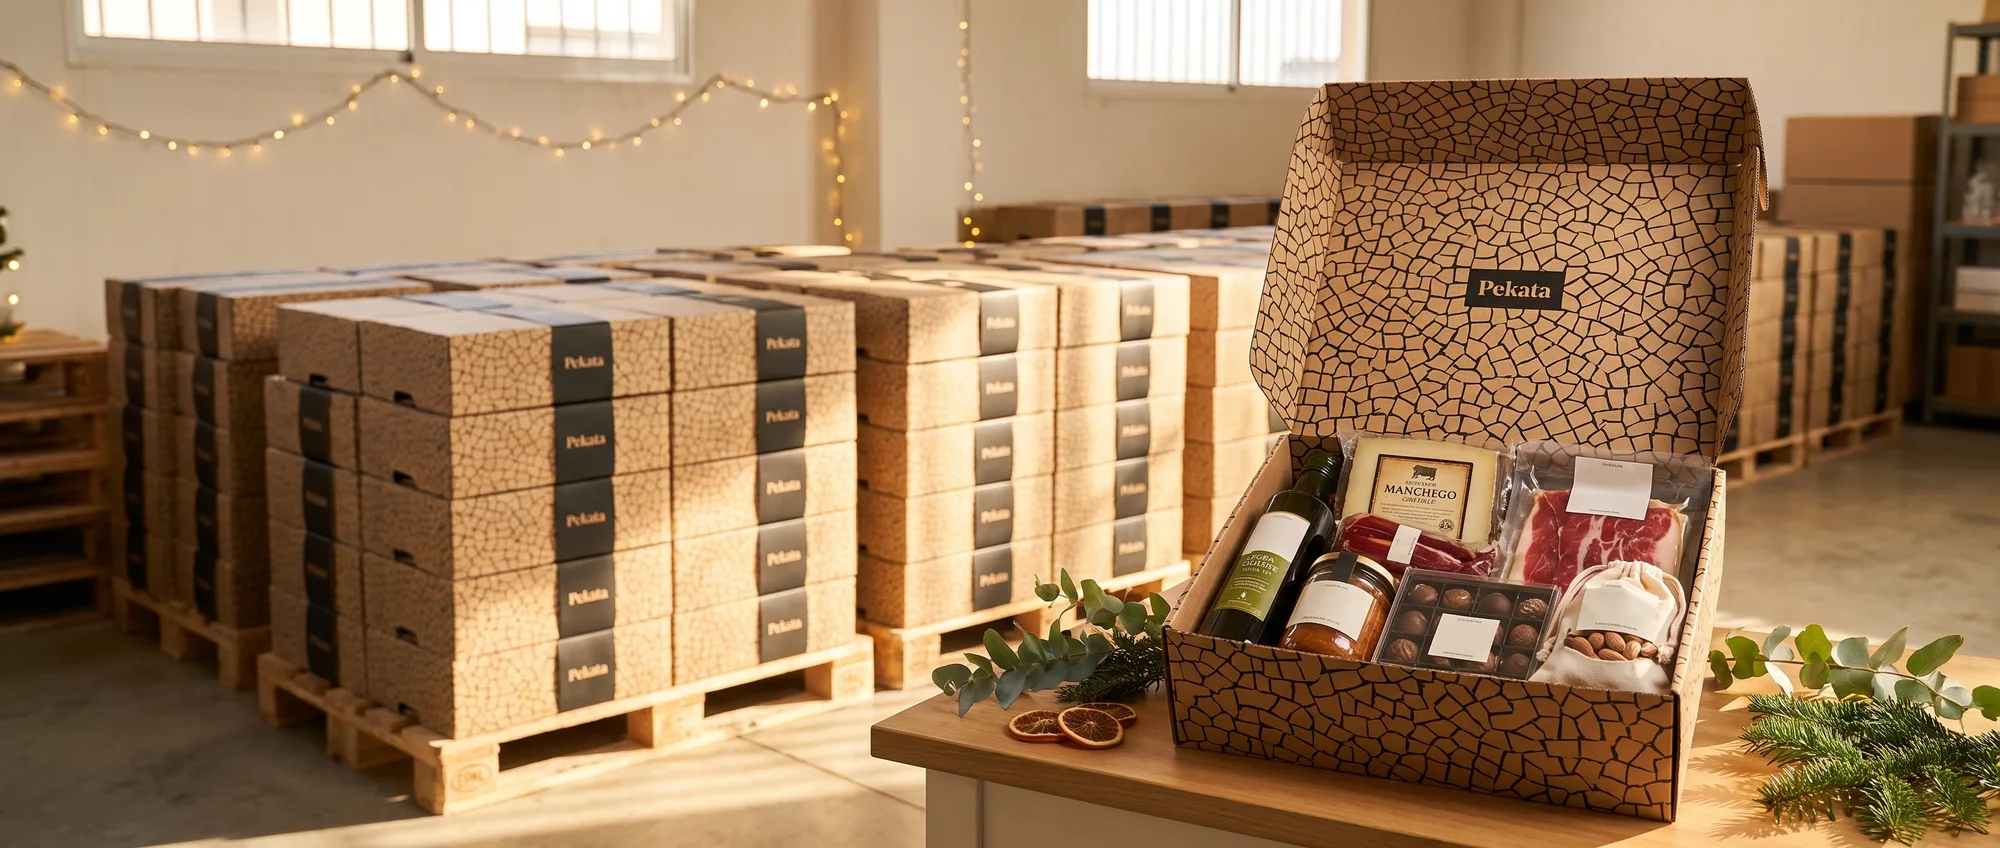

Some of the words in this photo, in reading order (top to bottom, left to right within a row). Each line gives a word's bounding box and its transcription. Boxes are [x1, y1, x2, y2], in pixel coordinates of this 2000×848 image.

[1478, 280, 1550, 298] Pekata
[766, 336, 801, 350] Pekata
[564, 355, 605, 370] Pekata
[765, 409, 800, 423] Pekata
[566, 434, 607, 449] Pekata
[766, 479, 802, 495] Pekata
[1384, 484, 1457, 500] MANCHEGO
[566, 511, 607, 528] Pekata
[766, 549, 802, 567] Pekata
[568, 588, 610, 607] Pekata
[767, 618, 803, 636] Pekata
[567, 663, 609, 683] Pekata
